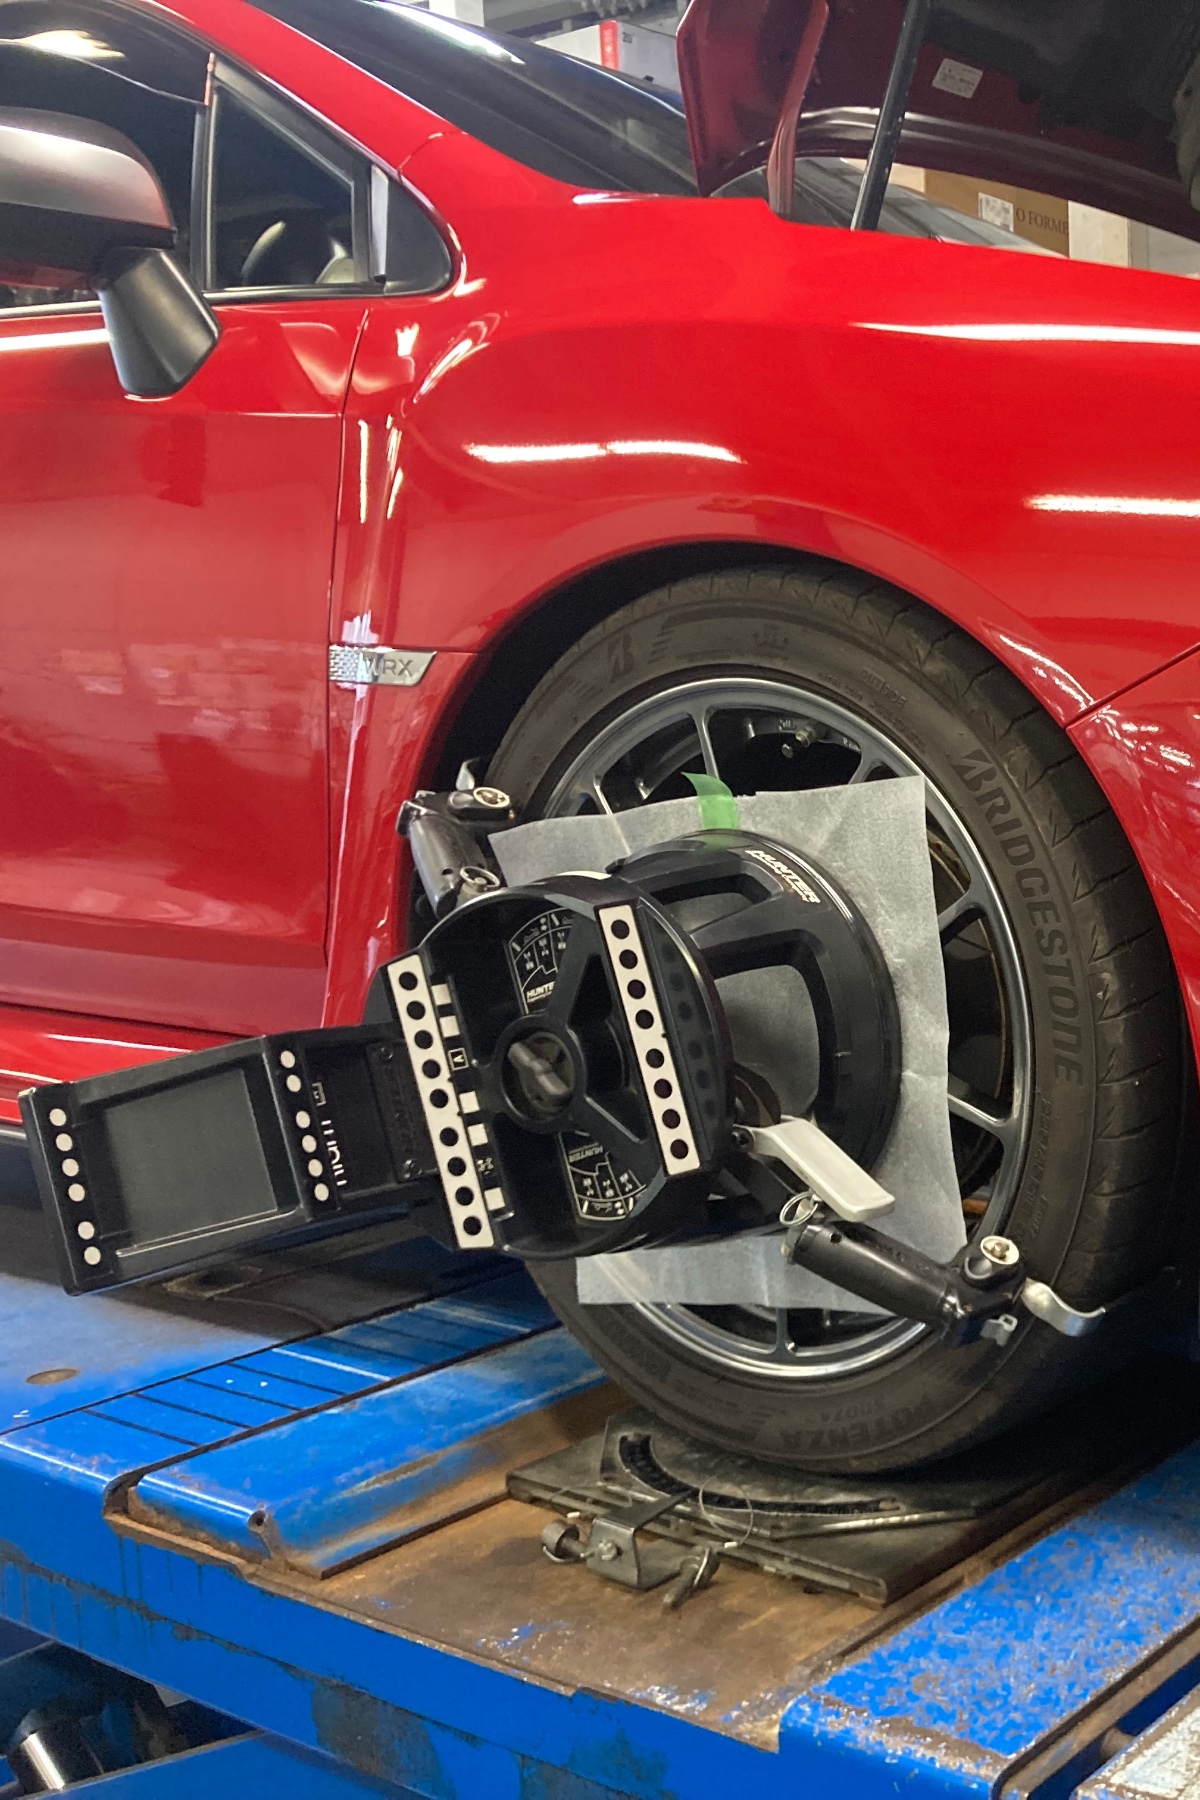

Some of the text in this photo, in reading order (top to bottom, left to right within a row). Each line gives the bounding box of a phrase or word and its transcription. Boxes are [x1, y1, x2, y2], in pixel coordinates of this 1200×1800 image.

[363, 656, 414, 677] WRX
[745, 850, 821, 903] HUNTER
[951, 749, 1085, 1088] BRIDGESTONE
